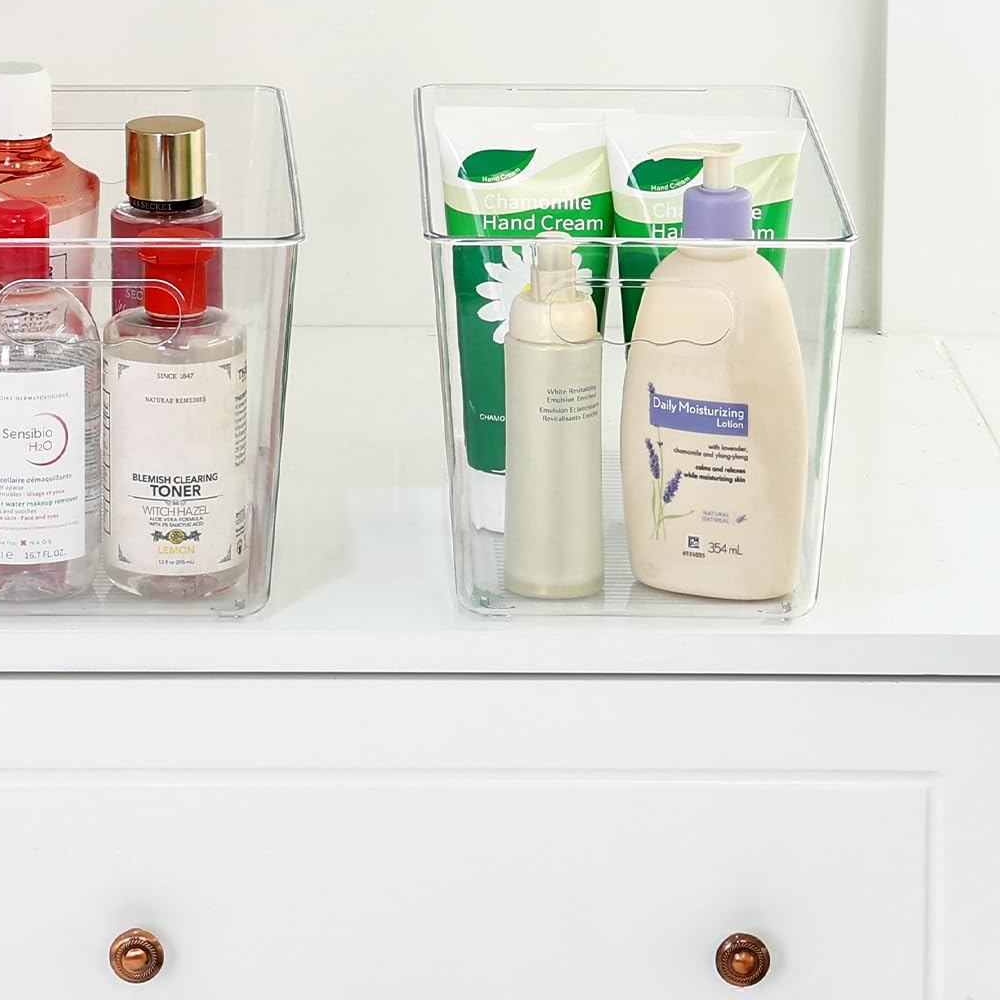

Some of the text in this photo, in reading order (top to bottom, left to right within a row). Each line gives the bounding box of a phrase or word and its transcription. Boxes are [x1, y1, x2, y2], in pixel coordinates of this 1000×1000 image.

[482, 167, 521, 183] Hand Cream
[651, 176, 691, 192] Hand Cream
[484, 194, 592, 211] Chamomile
[483, 214, 604, 231] Hand Cream
[156, 372, 194, 380] SINCE 1847
[176, 396, 206, 404] REMEDIES
[539, 406, 568, 414] Emulsion
[653, 396, 744, 420] Daily Moisturizing
[542, 414, 581, 422] Revitalisante
[716, 418, 744, 429] Lotion
[2, 427, 52, 440] Sensibio
[29, 440, 52, 452] H2O
[674, 448, 702, 456] chamomile
[715, 452, 748, 462] ylang-ylang
[695, 464, 710, 472] calms
[724, 466, 746, 474] relaxes
[26, 473, 72, 484] démaquillante
[132, 472, 218, 484] BLEMISH CLEARING
[699, 473, 733, 484] moisturizing
[150, 484, 201, 498] TONER
[26, 500, 53, 508] makeup
[54, 496, 78, 504] remover
[142, 506, 209, 516] WITCH HAZEL
[702, 510, 729, 518] NATURAL
[47, 514, 59, 522] eyes
[702, 516, 729, 524] OATMEAL
[158, 545, 195, 555] LEMON
[708, 542, 743, 556] 354 mL
[25, 552, 40, 560] 16.7
